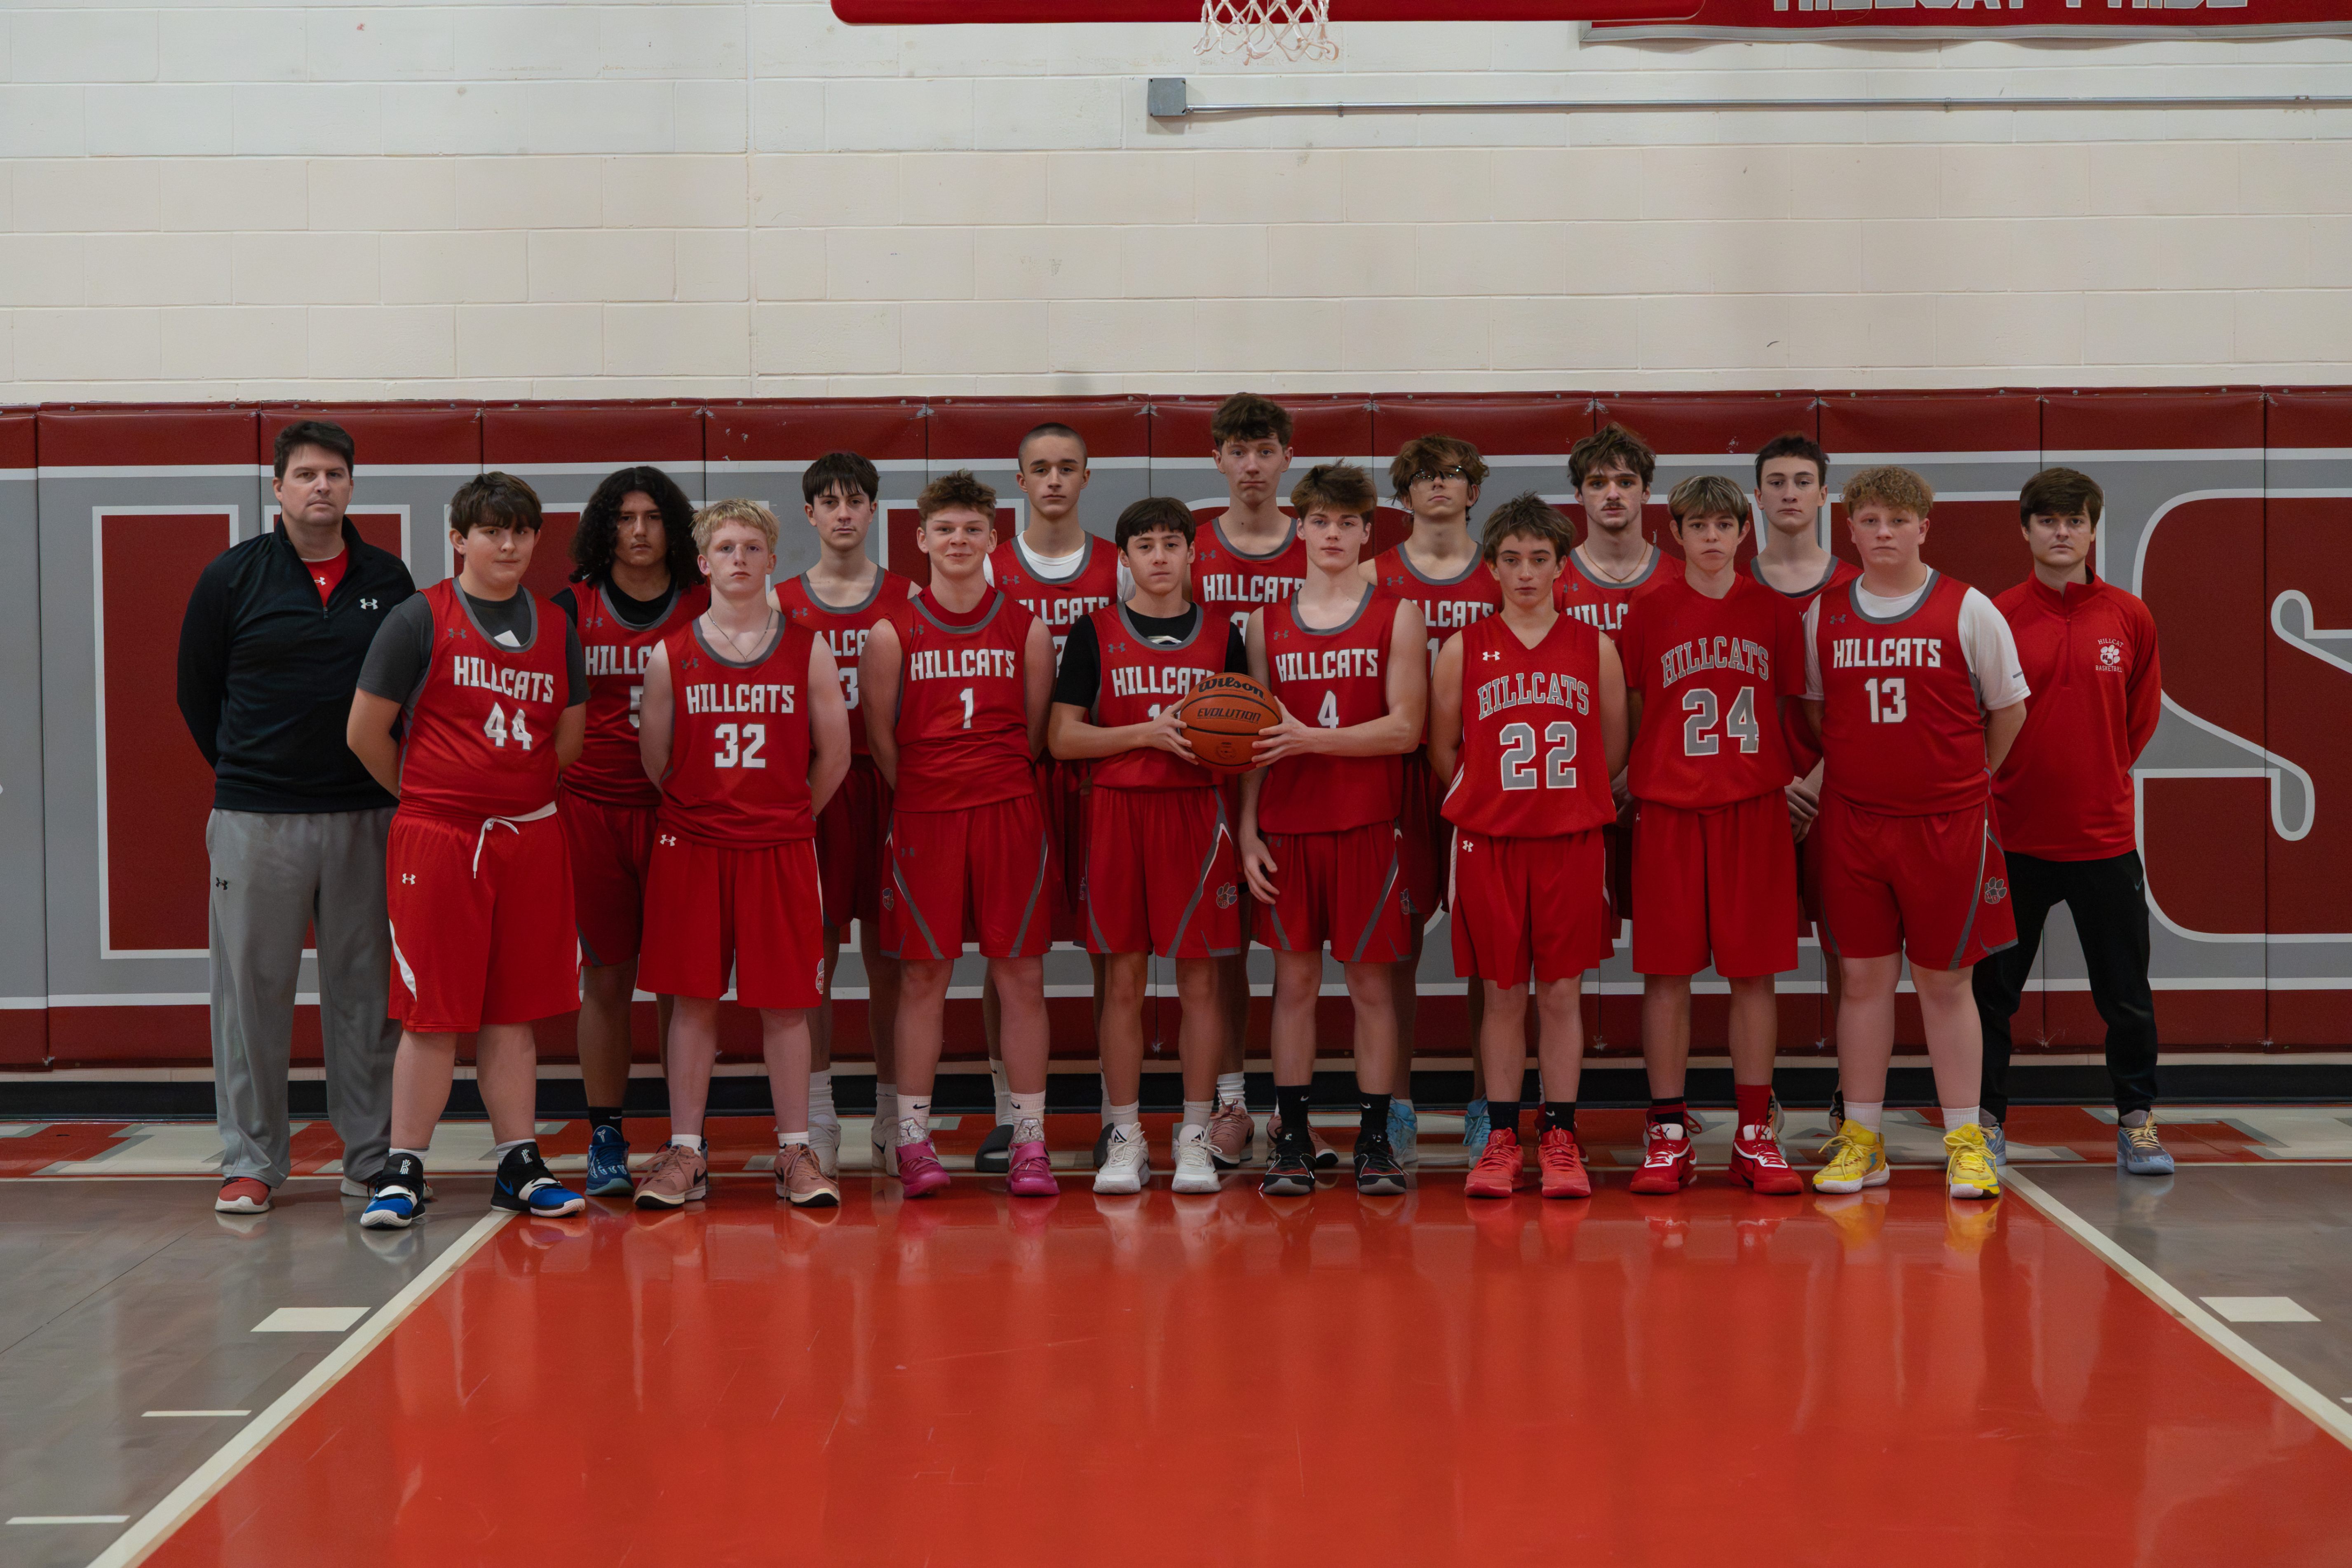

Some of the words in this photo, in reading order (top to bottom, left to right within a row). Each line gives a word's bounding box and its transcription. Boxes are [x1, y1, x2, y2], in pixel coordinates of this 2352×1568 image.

[585, 646, 652, 675] HILLC
[1661, 636, 1769, 688] HILLCATS
[1833, 638, 1941, 669] HILLCATS
[2098, 638, 2124, 647] HILLCAT
[454, 655, 554, 703] HILLCATS
[910, 648, 1015, 681] HILLCATS
[1111, 665, 1216, 697] HILLCAT
[1275, 648, 1379, 683] HILLCATS
[686, 683, 795, 714] HILLCATS
[1199, 677, 1265, 700] Wilson
[1477, 672, 1589, 720] HILLCATS
[1864, 677, 1907, 723] 13
[484, 702, 533, 751] 44
[959, 688, 974, 729] 1
[1197, 707, 1261, 722] EVOLUTION
[1317, 690, 1339, 729] 4
[1683, 686, 1759, 756] 24
[714, 723, 766, 768] 32
[1499, 721, 1577, 791] 22
